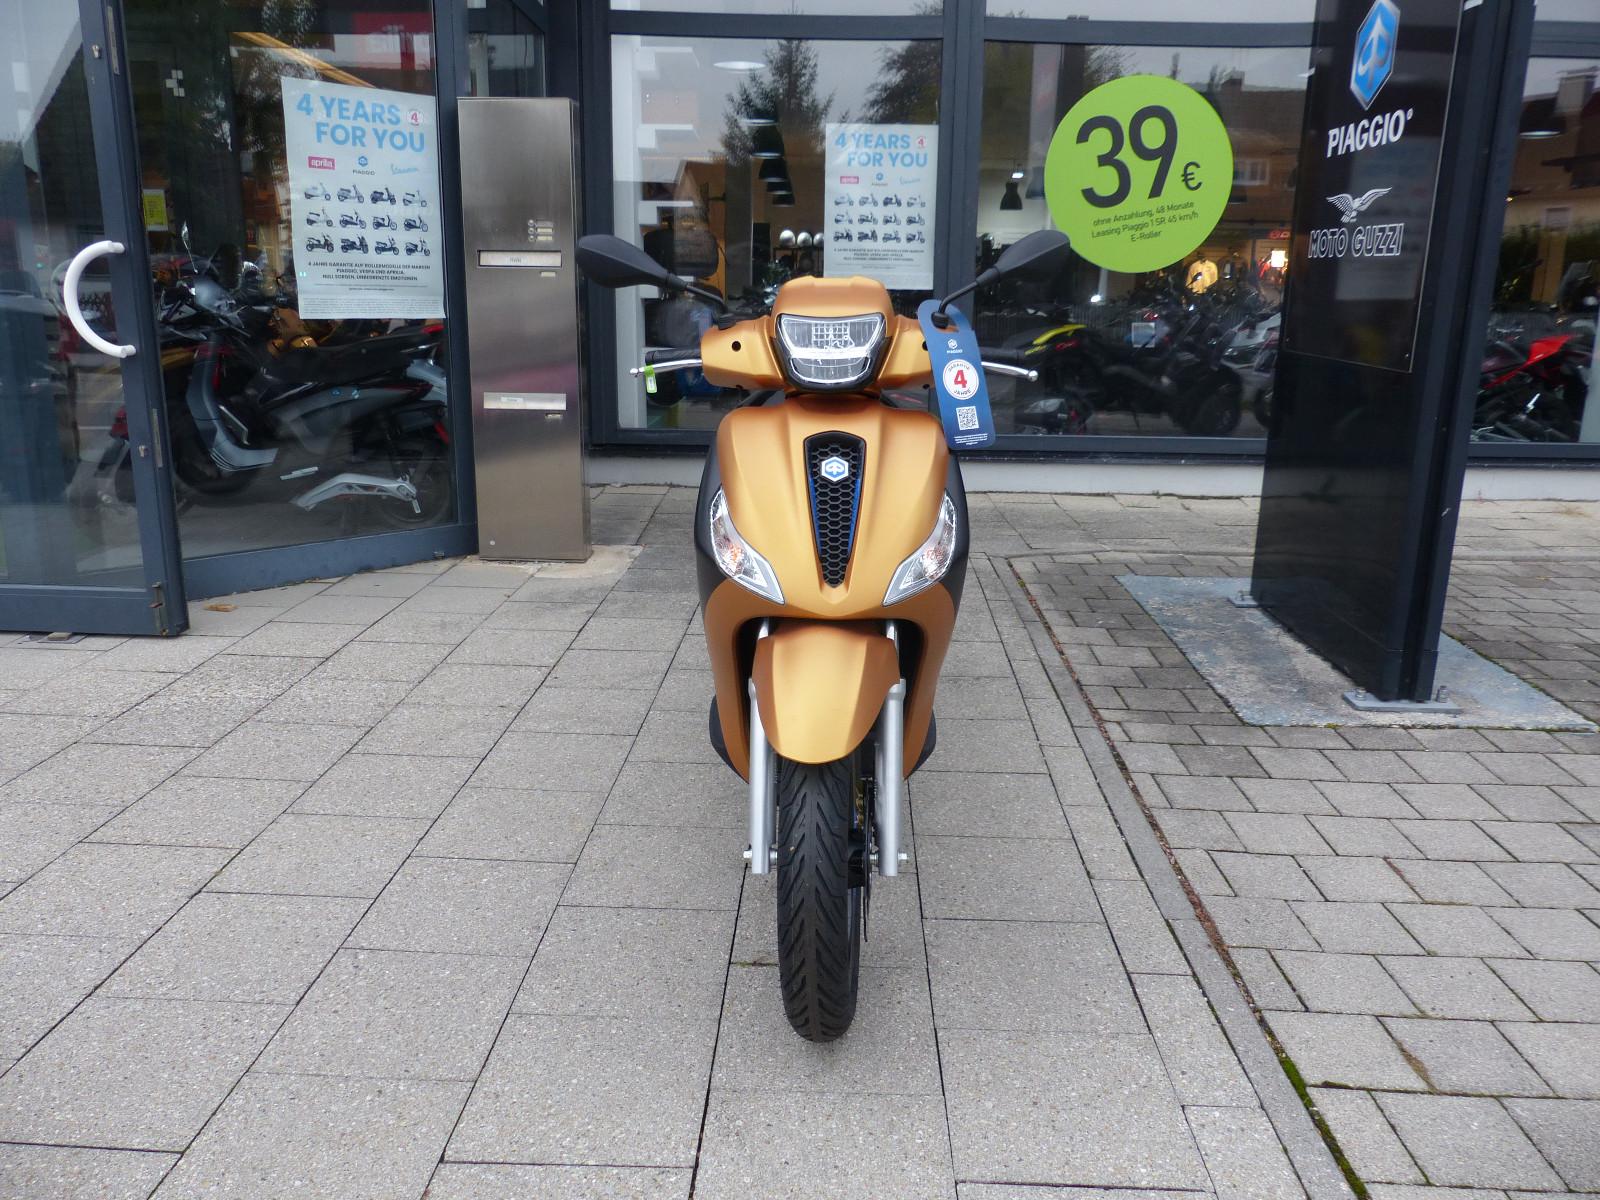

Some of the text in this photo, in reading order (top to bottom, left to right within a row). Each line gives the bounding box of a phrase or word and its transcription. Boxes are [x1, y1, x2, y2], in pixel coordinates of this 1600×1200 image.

[296, 93, 401, 126] 4 YEARS
[315, 122, 425, 153] FOR YOU
[835, 132, 911, 150] 4 YEARS
[847, 152, 928, 168] FOR YOU
[1075, 104, 1203, 208] 39 €
[1091, 226, 1121, 239] Leasing
[1122, 222, 1150, 233] Piaggio
[1179, 211, 1199, 221] km/h
[1093, 217, 1112, 226] ohne
[1156, 206, 1165, 214] 48
[1167, 201, 1194, 212] Monate
[1130, 230, 1162, 242] E-Roller
[1307, 223, 1405, 259] MOTO GUZZI
[953, 369, 968, 389] 4
[953, 388, 972, 396] JAHRE
